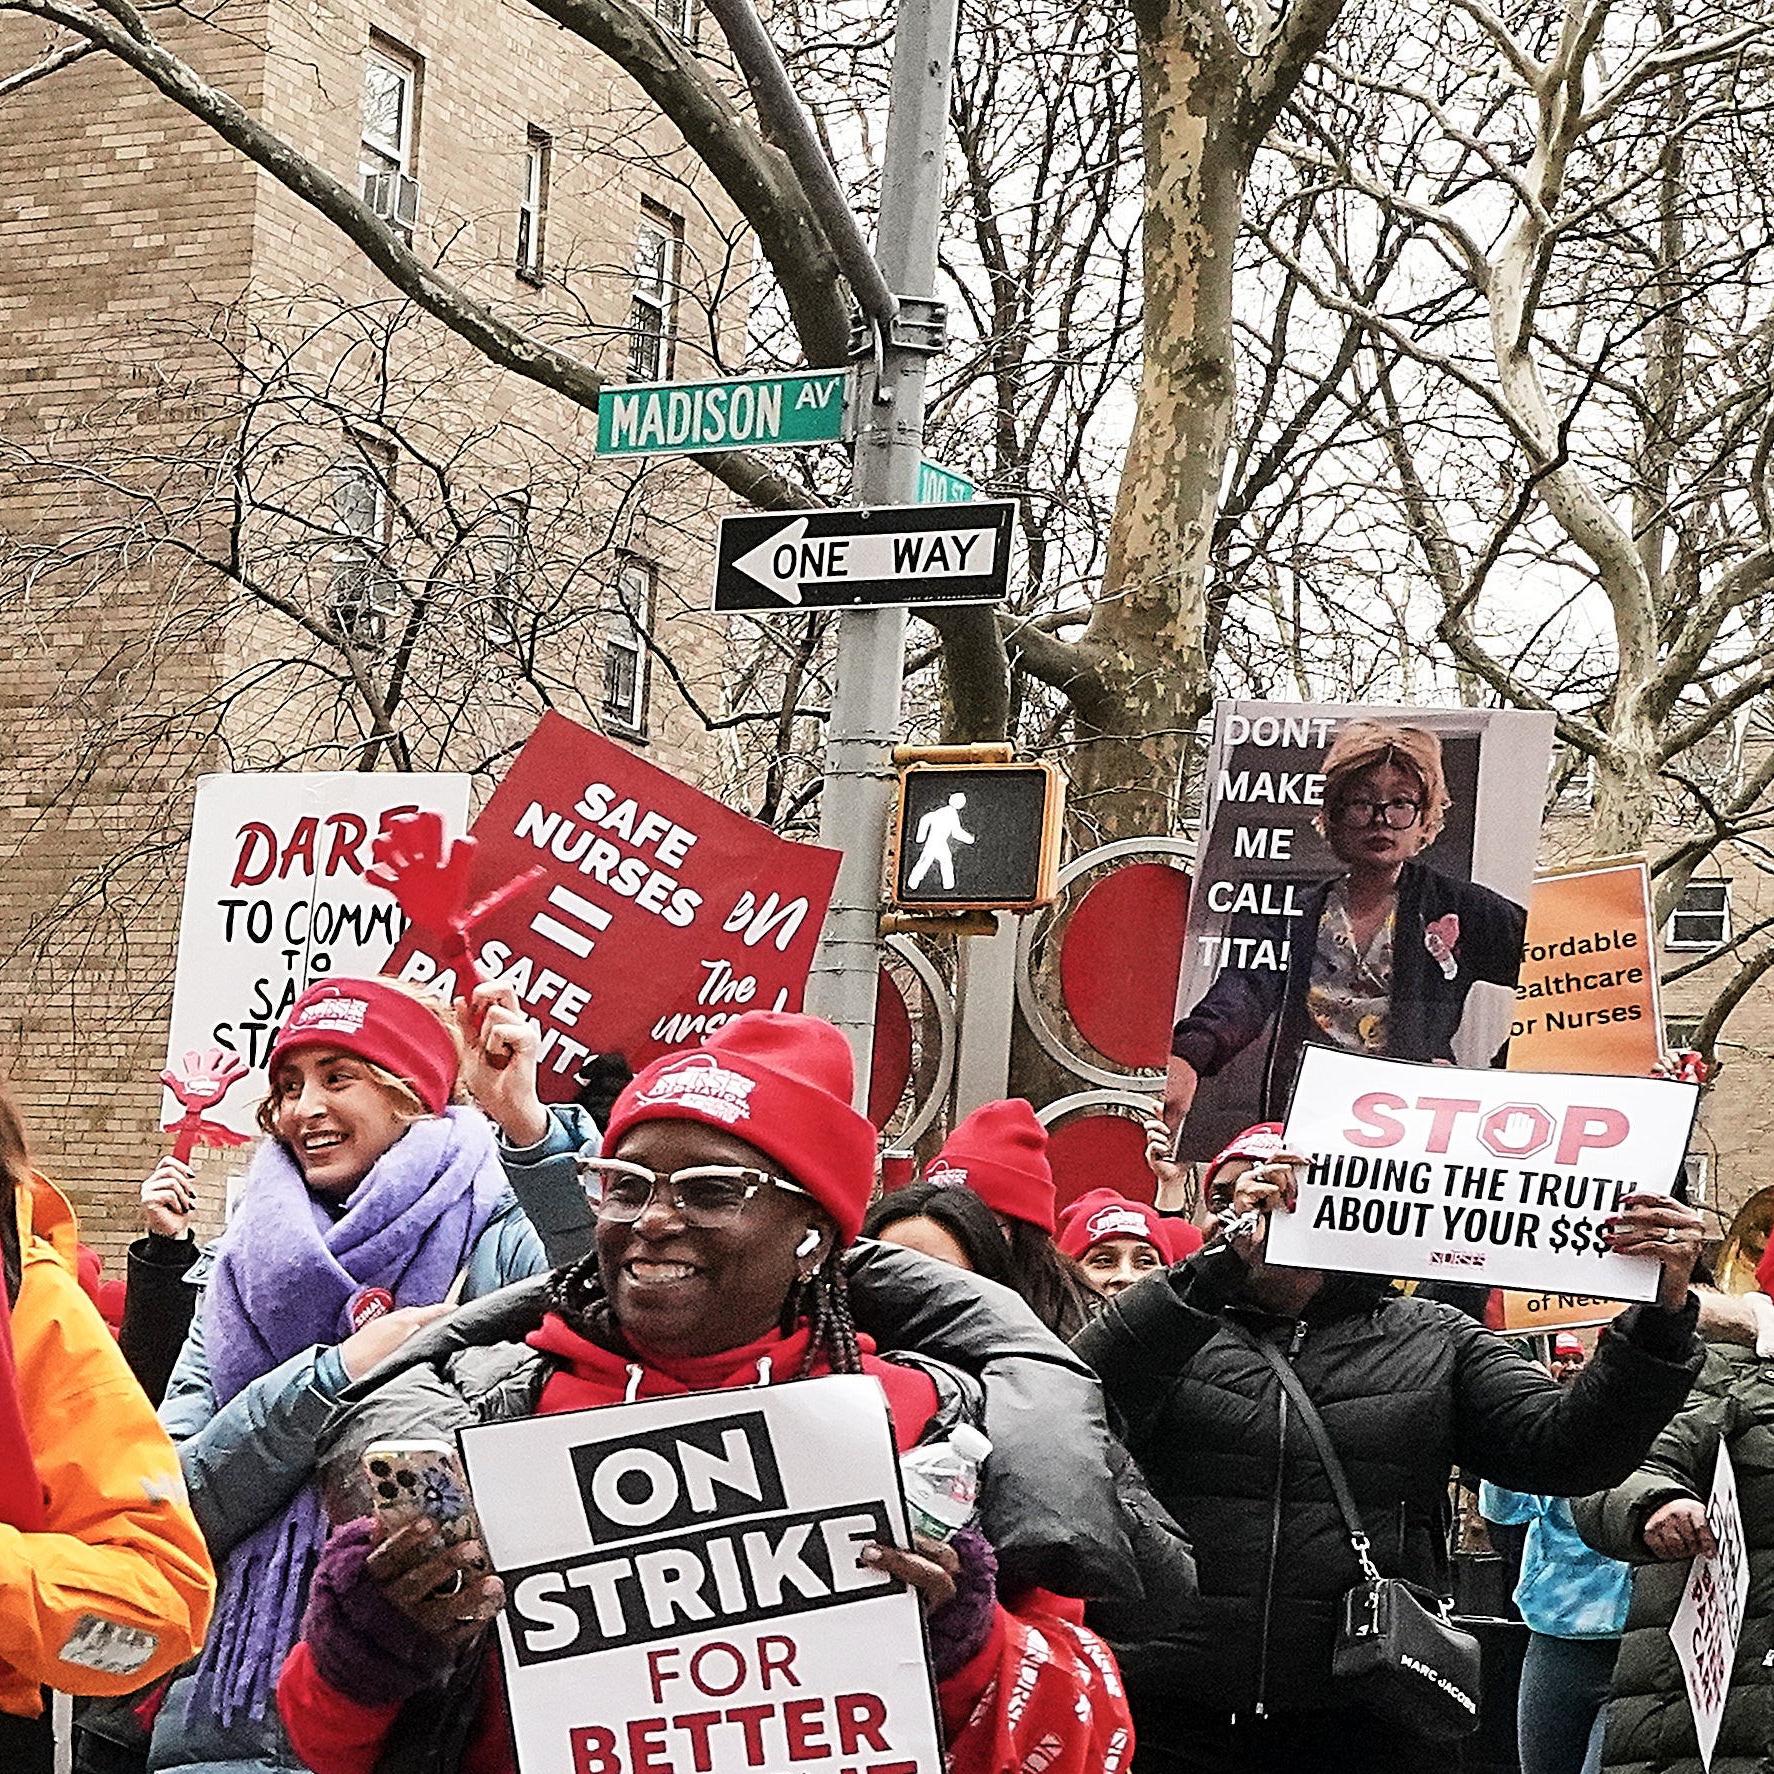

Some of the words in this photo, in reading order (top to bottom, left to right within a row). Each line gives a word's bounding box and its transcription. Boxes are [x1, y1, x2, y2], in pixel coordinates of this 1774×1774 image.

[610, 384, 782, 448] MADISON
[772, 539, 850, 580] ONE
[893, 533, 981, 574] WAY
[1224, 713, 1337, 751] DONT
[1218, 770, 1326, 807] MAKE
[573, 782, 698, 870] SAFE
[1234, 826, 1293, 861] ME
[514, 801, 704, 930] NURSES
[217, 899, 273, 944] TO
[1207, 881, 1304, 918] CALL
[282, 950, 332, 973] TO
[1198, 935, 1292, 973] TITA!
[473, 940, 593, 1027] SAFE
[1545, 1003, 1642, 1033] Nurses
[1306, 1152, 1432, 1196] HIDING
[1434, 1163, 1506, 1202] THE
[1312, 1195, 1435, 1238] ABOUT
[1442, 1206, 1539, 1250] YOUR
[1527, 1294, 1551, 1312] of
[591, 1428, 765, 1529] ON
[511, 1512, 892, 1653] STRIKE
[645, 1634, 802, 1704] FOR
